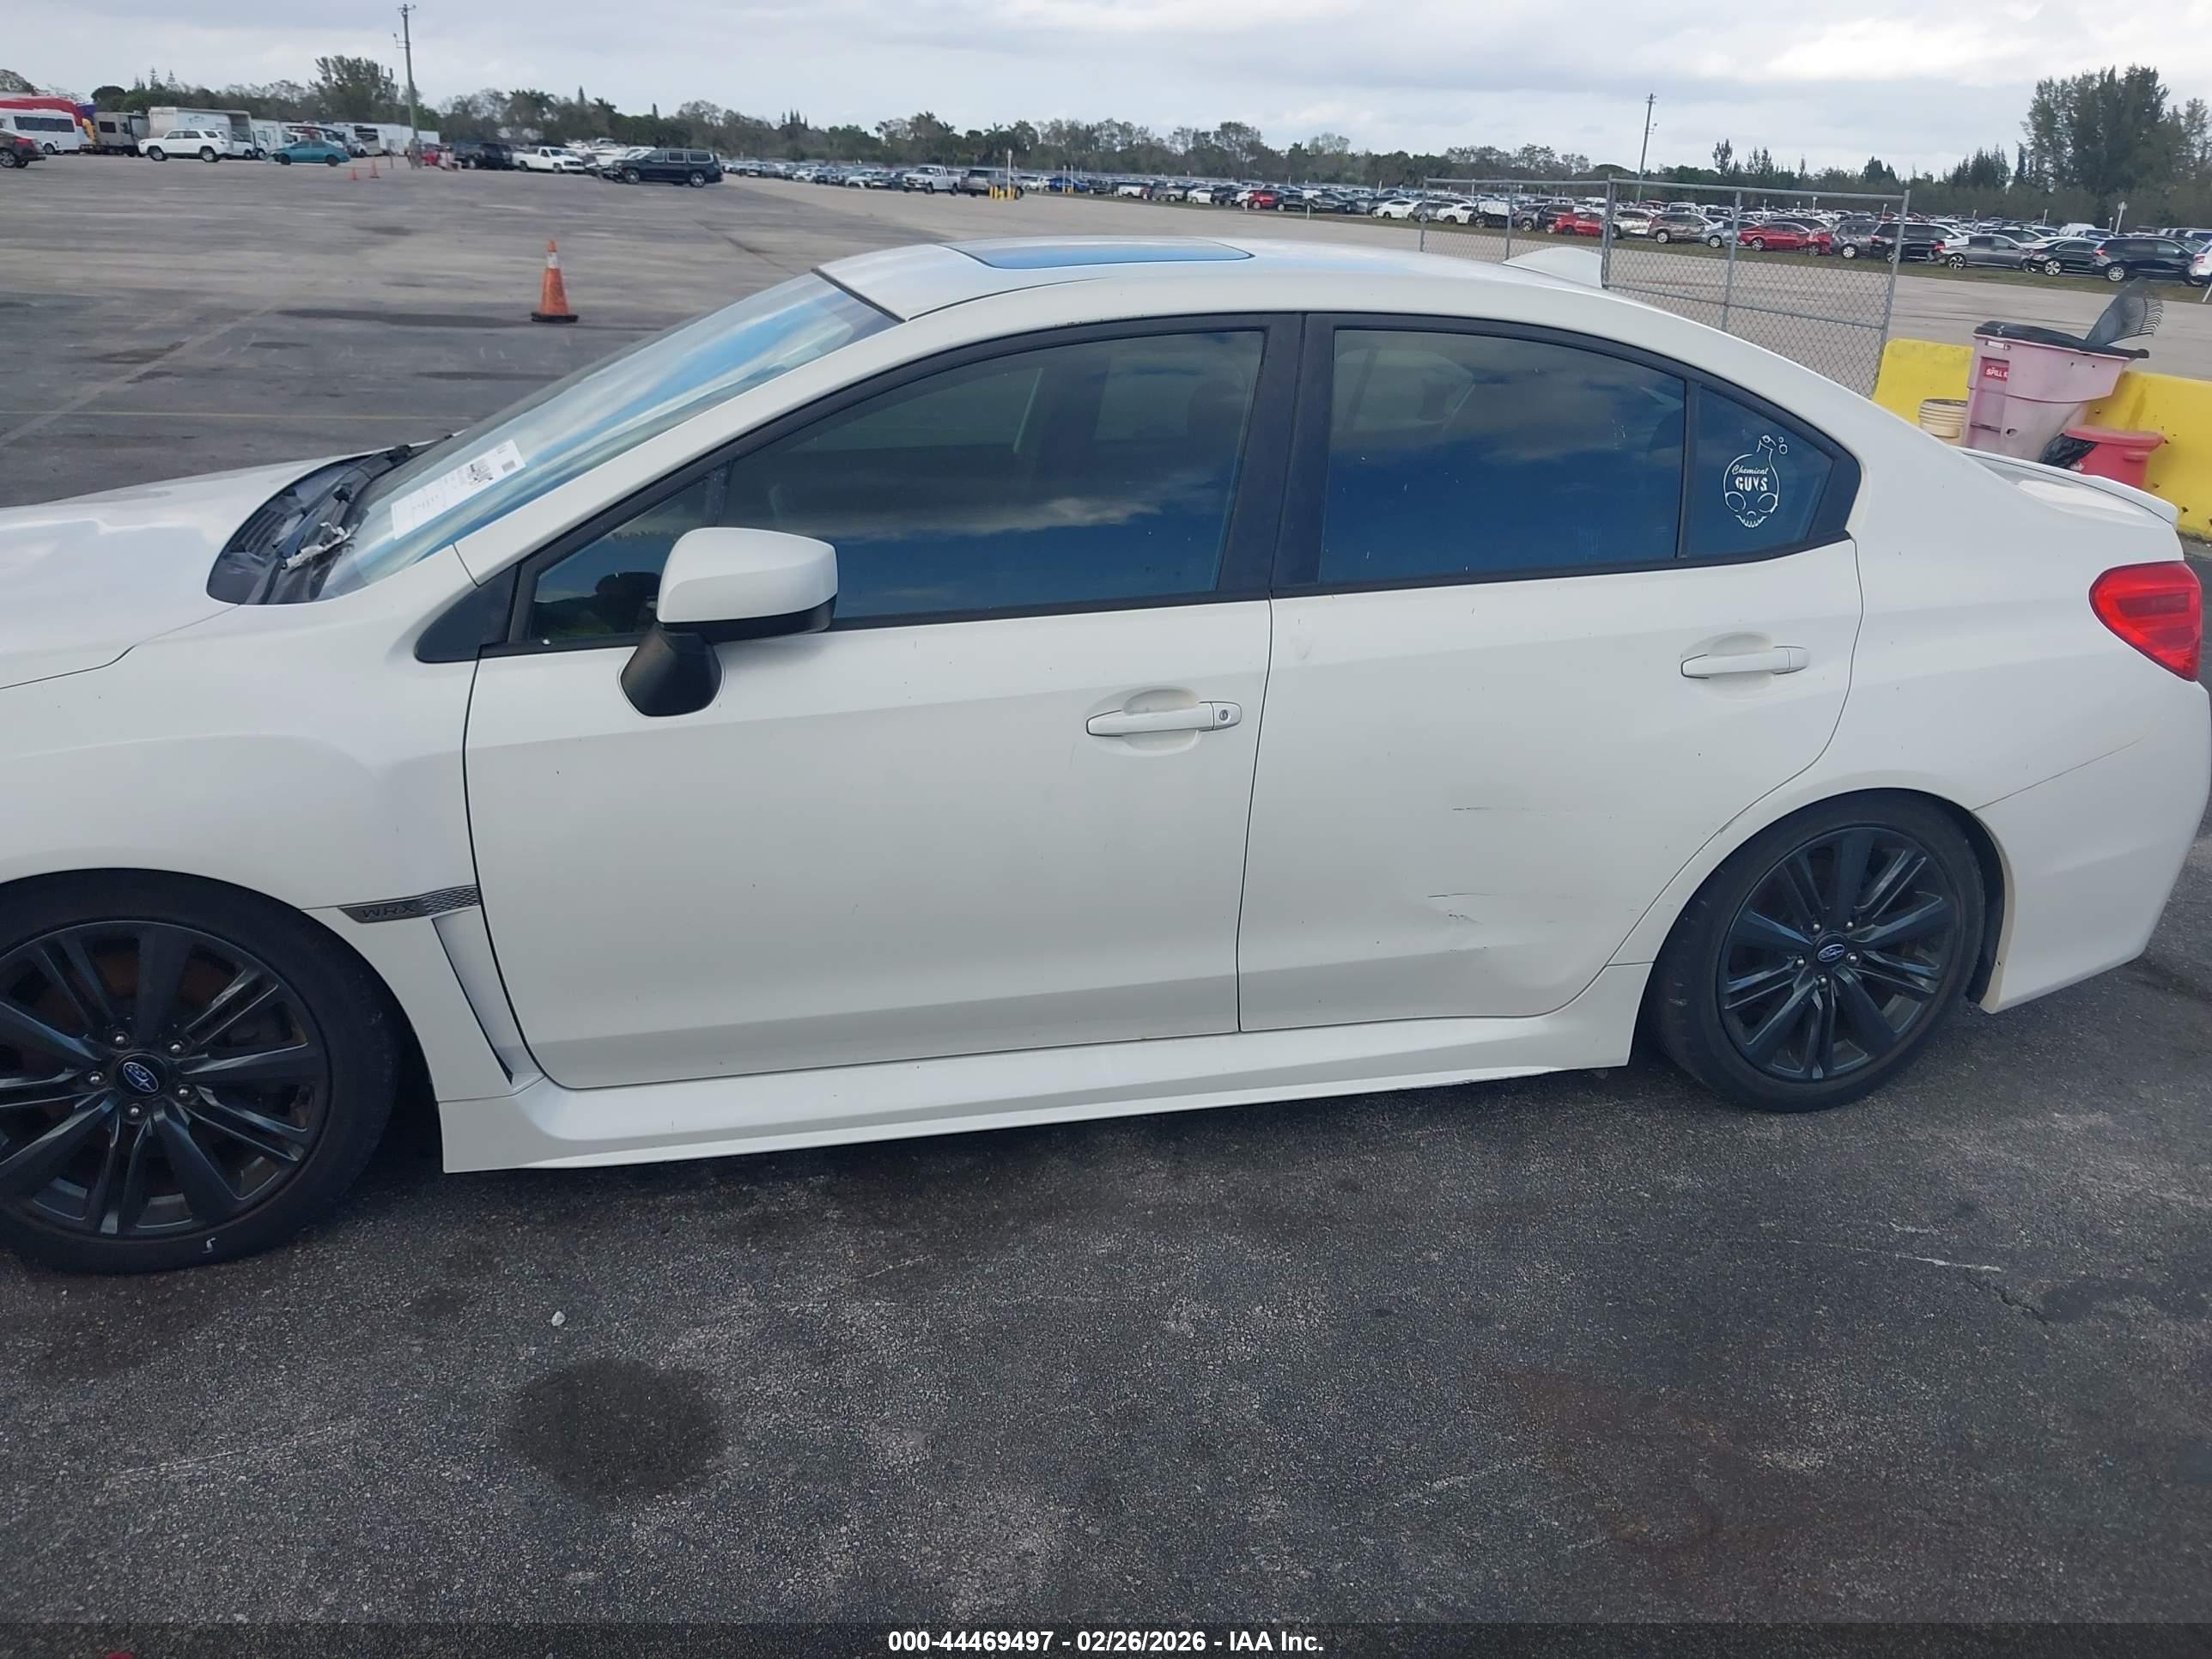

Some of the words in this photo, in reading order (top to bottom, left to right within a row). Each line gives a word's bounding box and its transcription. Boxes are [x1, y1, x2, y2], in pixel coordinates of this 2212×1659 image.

[1731, 465, 1769, 475] Chemical
[1735, 477, 1769, 491] GUYS
[362, 904, 415, 918] WRX
